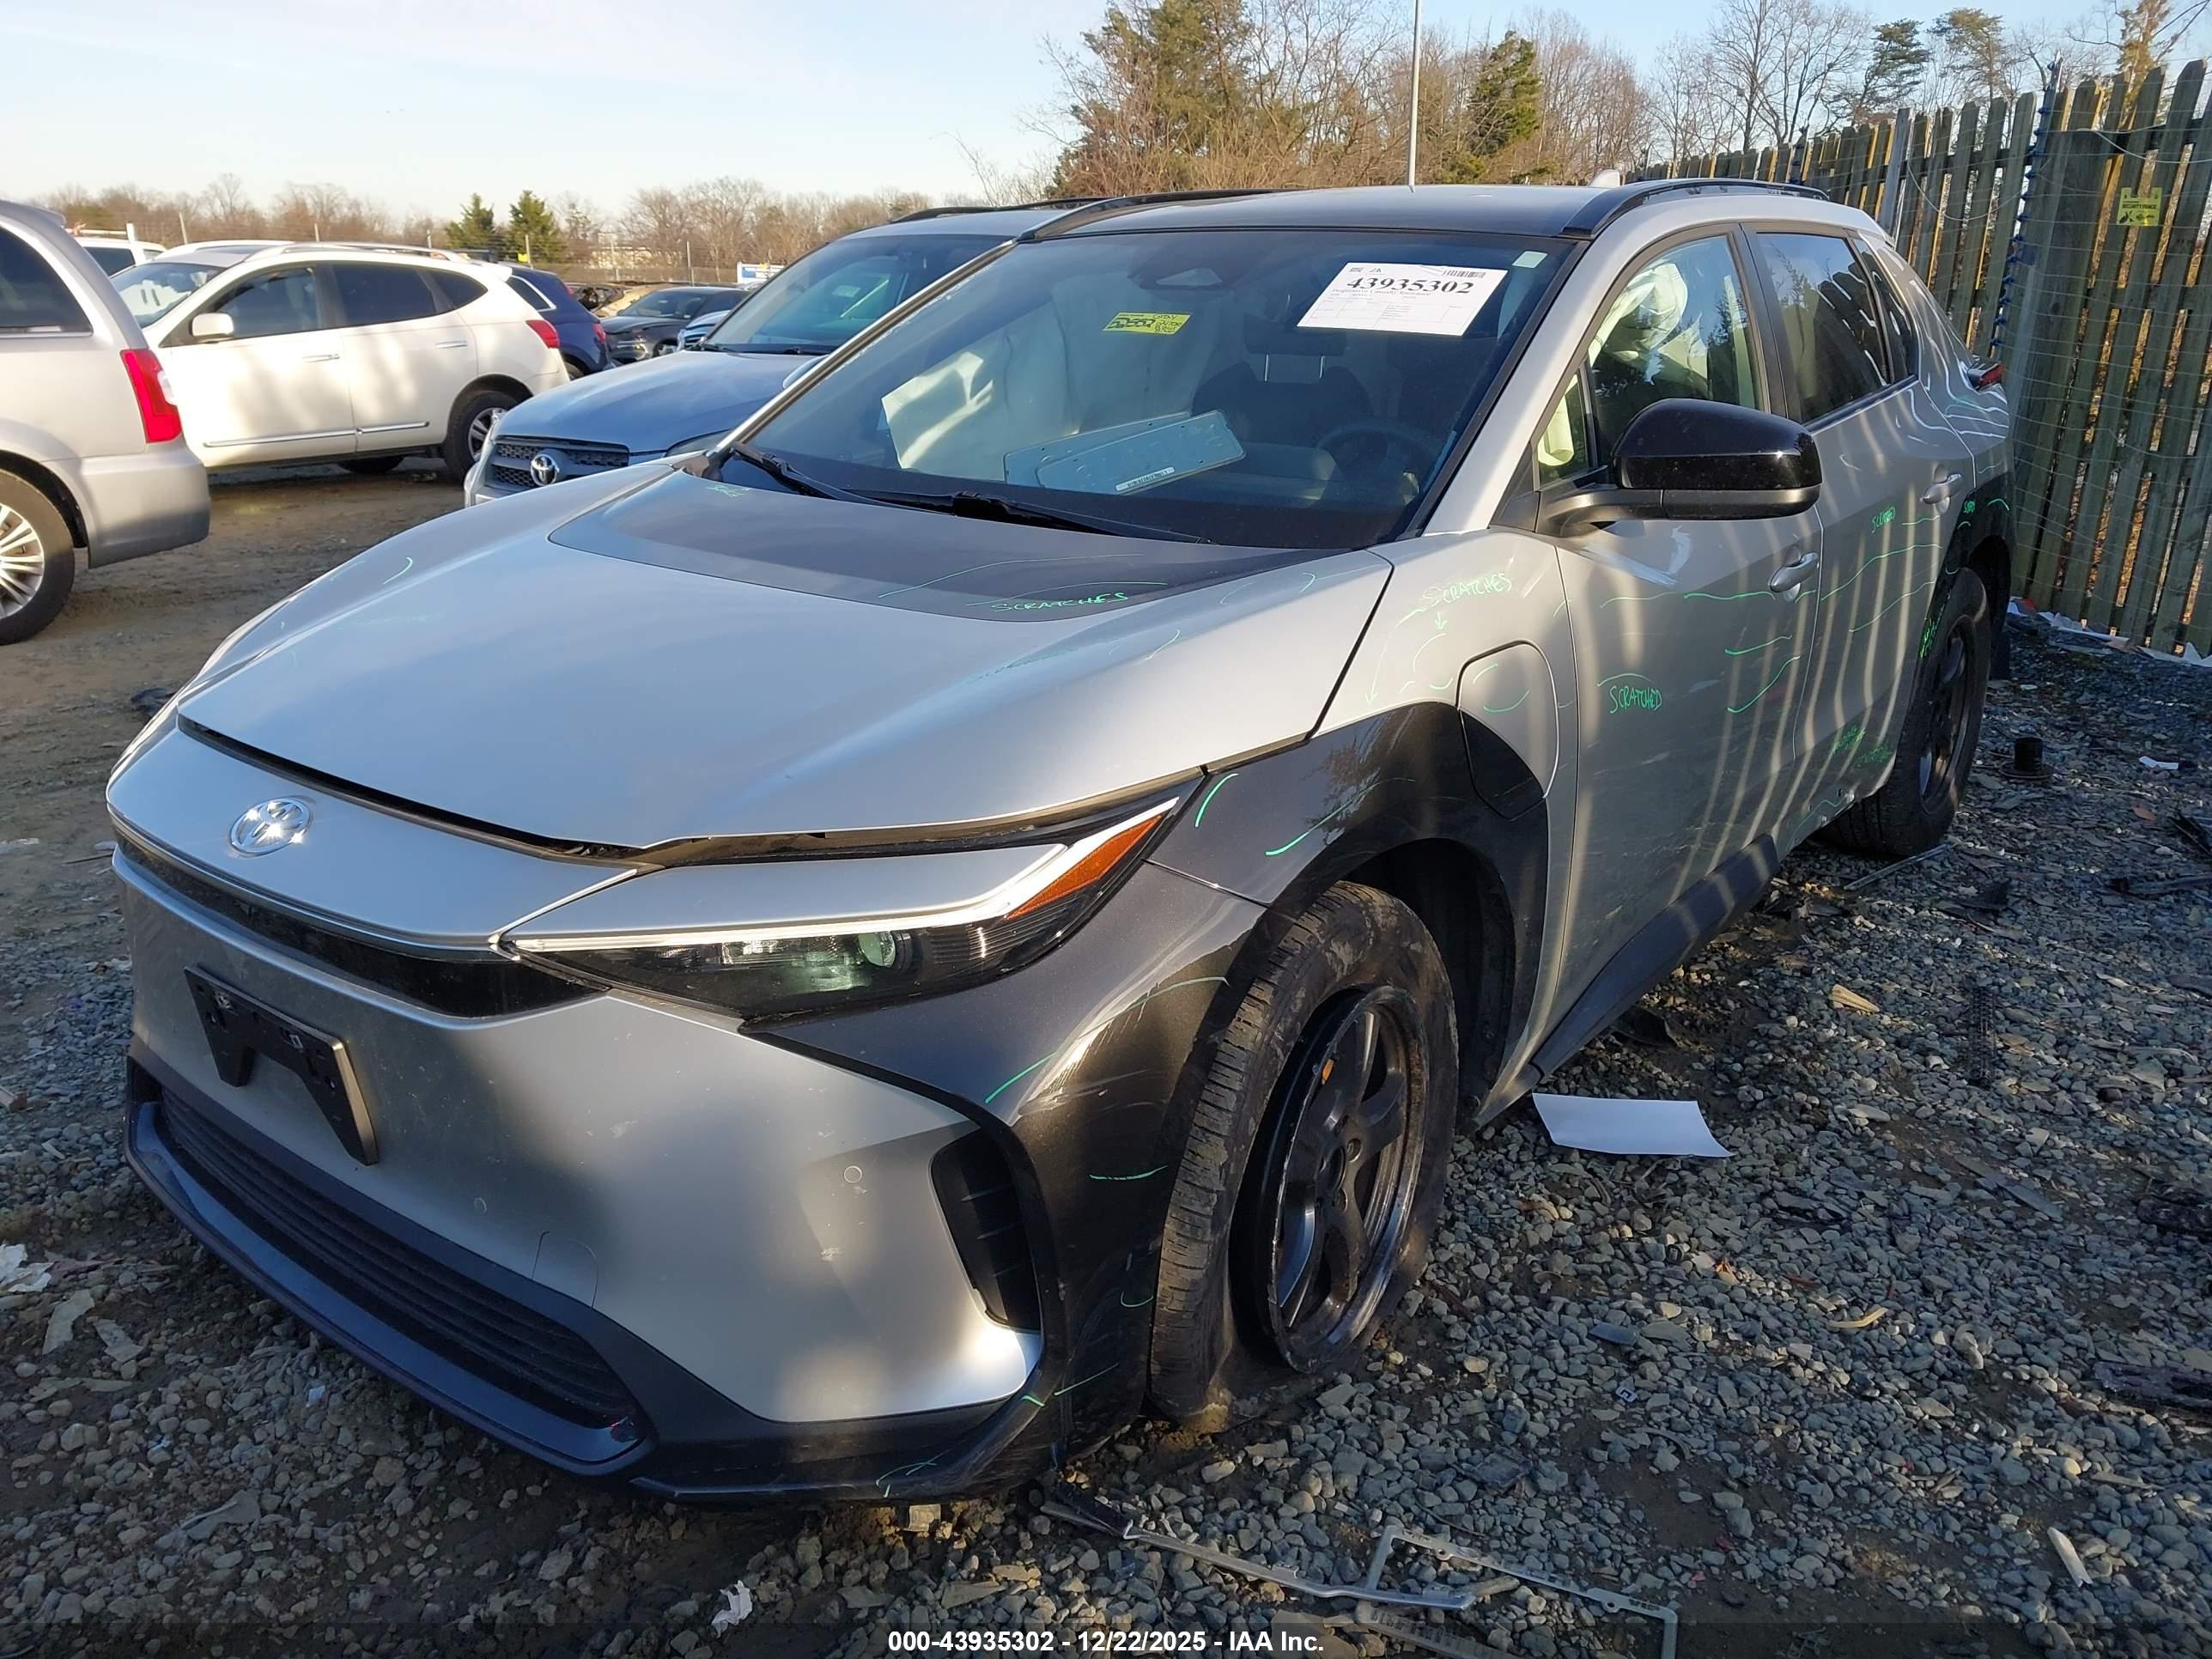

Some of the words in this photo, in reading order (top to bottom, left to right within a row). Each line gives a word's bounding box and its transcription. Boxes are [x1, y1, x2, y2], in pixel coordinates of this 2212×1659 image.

[1346, 276, 1474, 294] 43935302
[991, 592, 1129, 612] SCRATCHES
[1422, 573, 1512, 607] SCRATCHES
[1609, 685, 1662, 714] SCRATCHED
